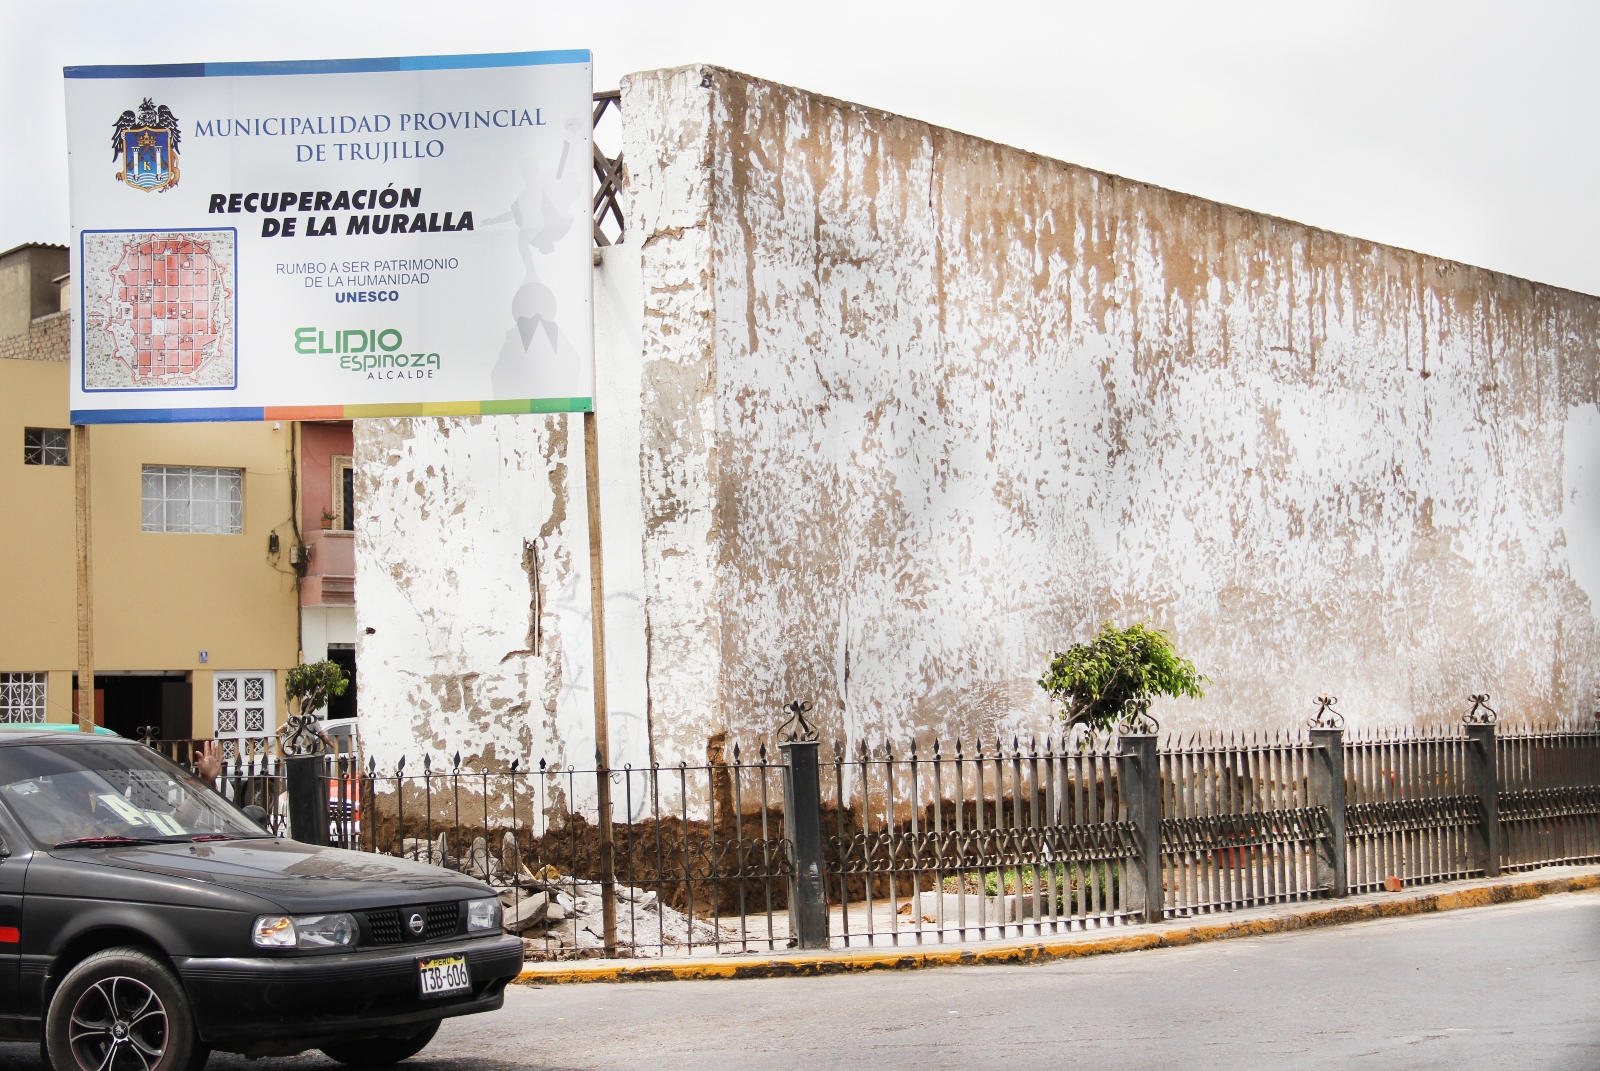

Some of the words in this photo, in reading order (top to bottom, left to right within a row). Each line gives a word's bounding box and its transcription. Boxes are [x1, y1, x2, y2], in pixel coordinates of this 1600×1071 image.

[194, 114, 391, 137] MUNICIPALIDAD
[399, 108, 546, 131] PROVINCIAL
[296, 144, 327, 162] DE
[333, 139, 444, 165] TRUJILLO
[208, 183, 422, 213] RECUPERACIÓN
[261, 217, 297, 237] DE
[306, 216, 337, 236] LA
[346, 211, 474, 235] MURALLA
[276, 262, 327, 274] RUMBO
[329, 262, 340, 273] A
[342, 261, 370, 272] SER
[374, 257, 459, 271] PATRIMONIO
[304, 276, 324, 287] DE
[327, 275, 344, 287] LA
[347, 272, 430, 286] HUMANIDAD
[335, 290, 399, 303] UNESCO
[294, 327, 403, 354] ELIDIO
[367, 369, 433, 380] ALCALDE
[421, 962, 468, 992] T3B-606
